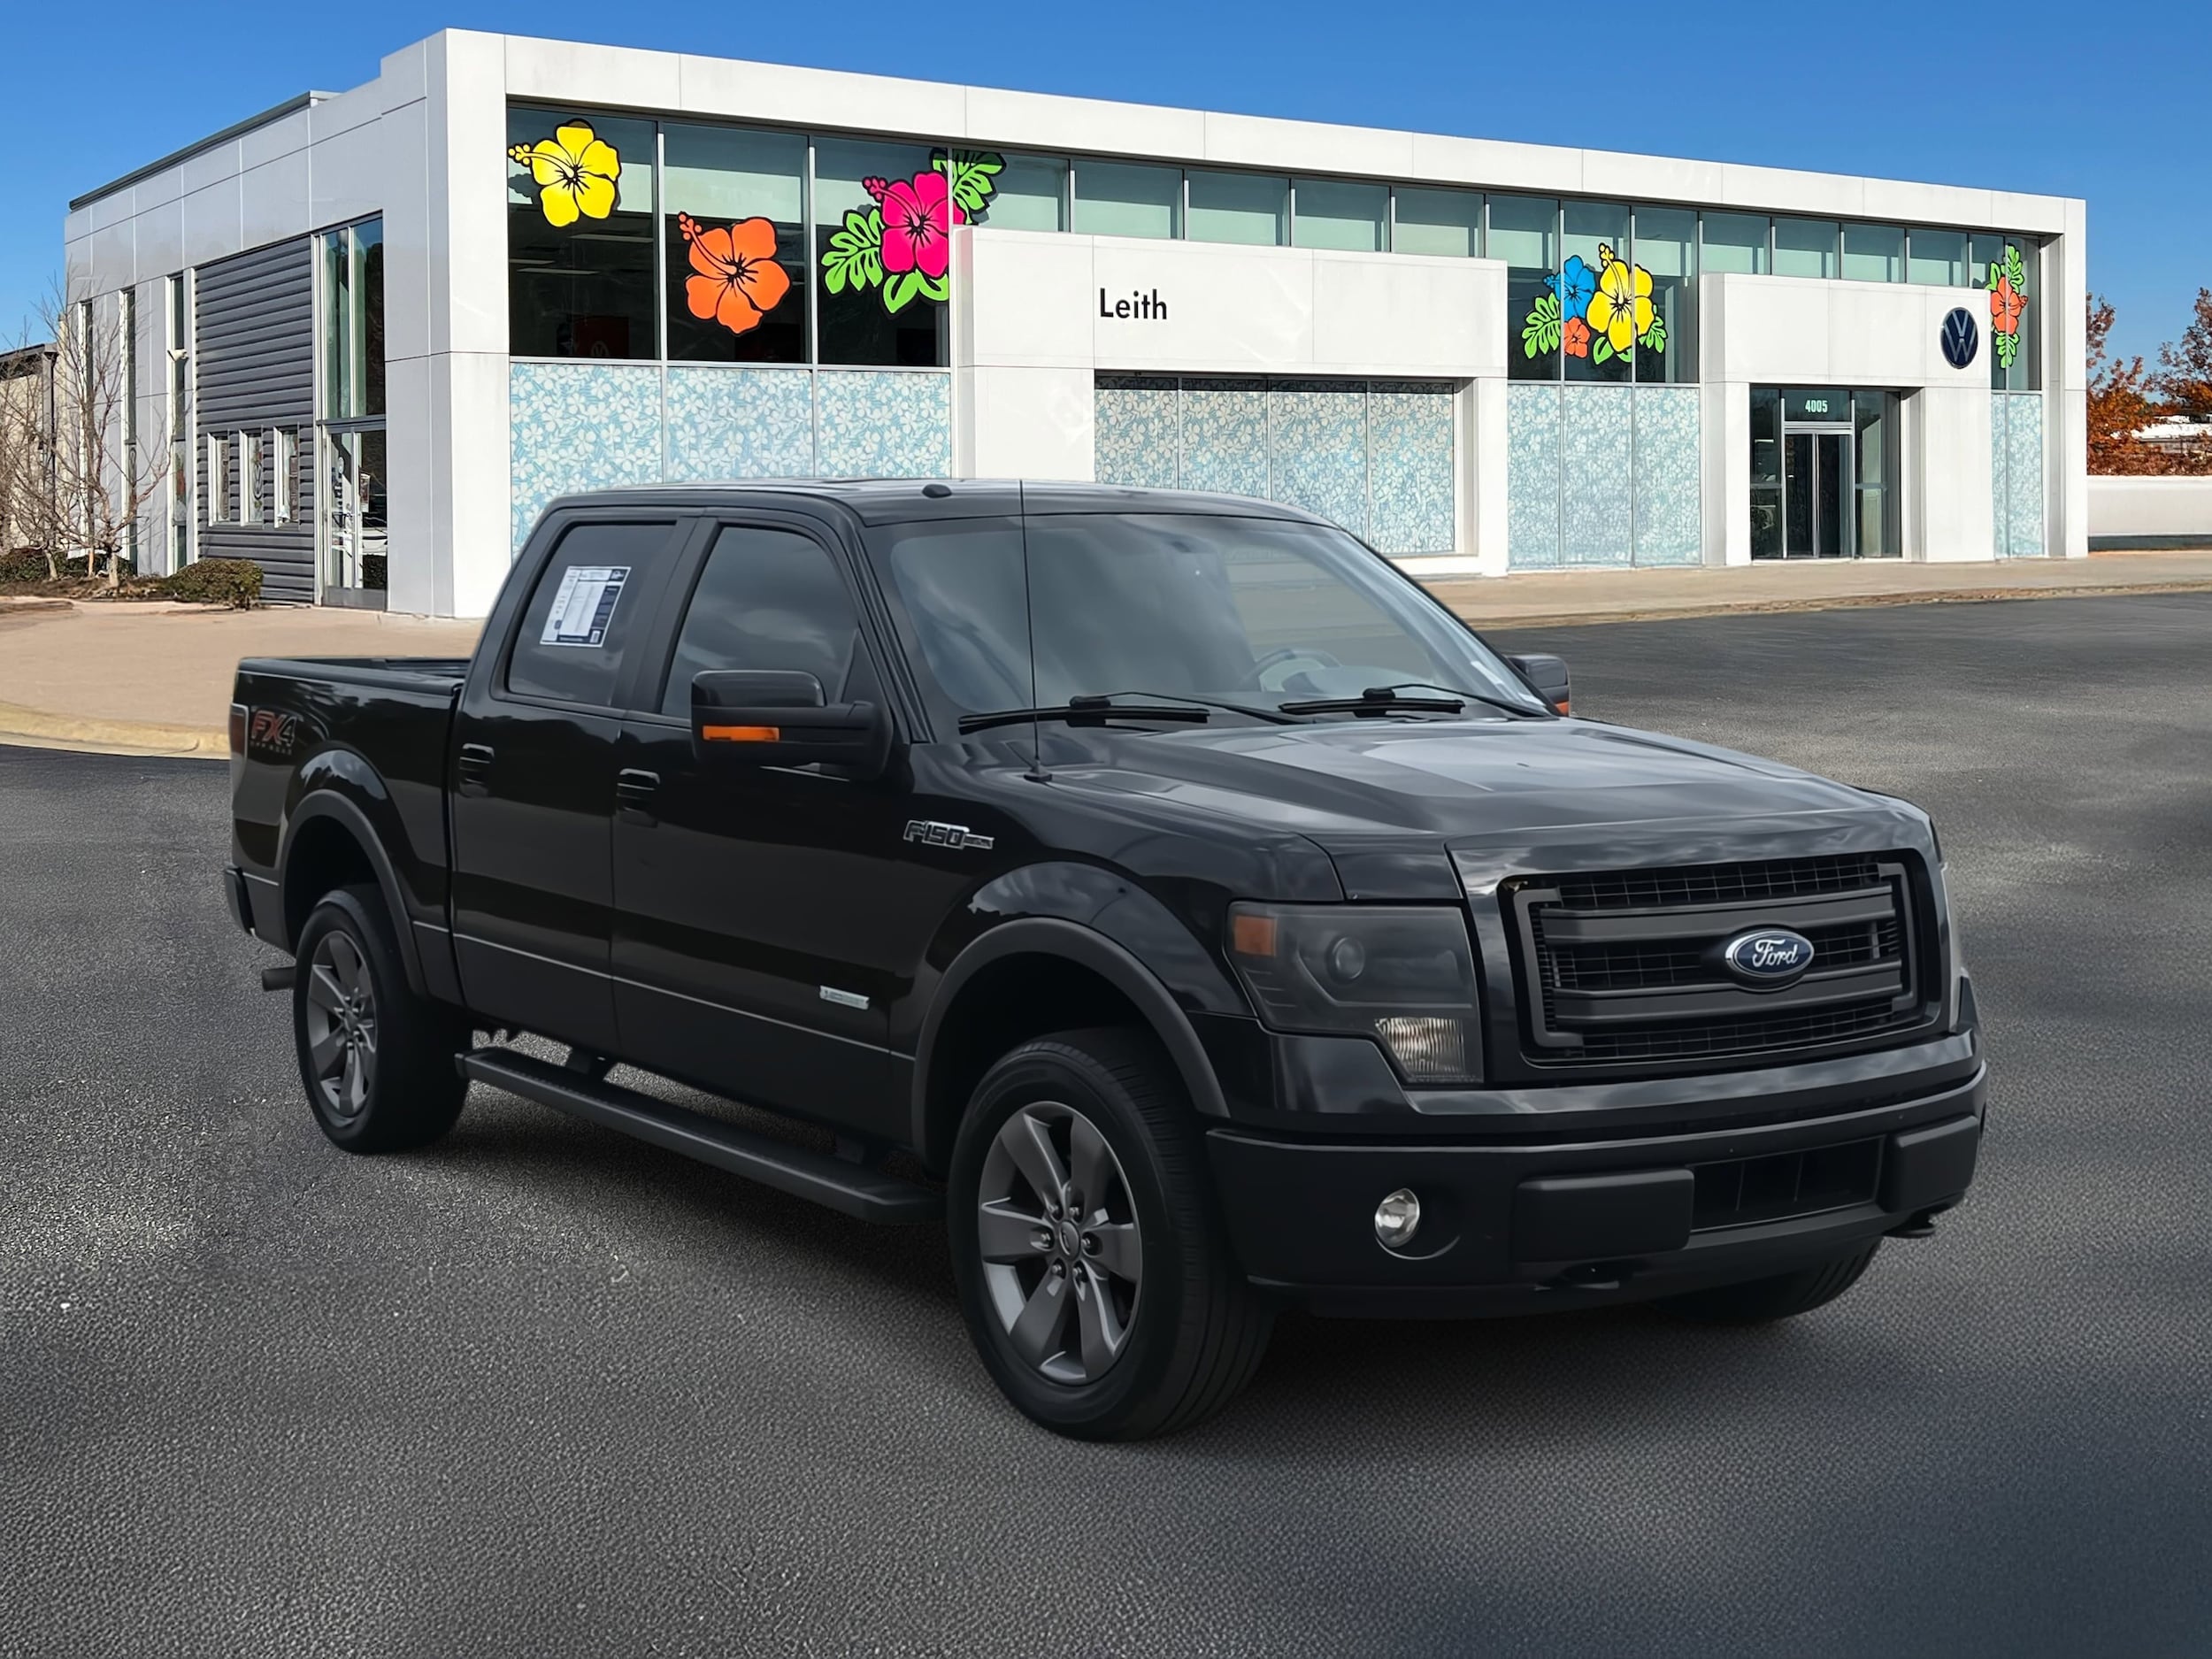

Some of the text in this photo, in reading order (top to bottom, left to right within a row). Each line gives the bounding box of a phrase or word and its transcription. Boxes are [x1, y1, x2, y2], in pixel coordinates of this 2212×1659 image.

[1100, 288, 1167, 319] Leith
[1805, 400, 1828, 413] 4005
[251, 710, 297, 747] FX4
[1752, 939, 1798, 968] Ford
